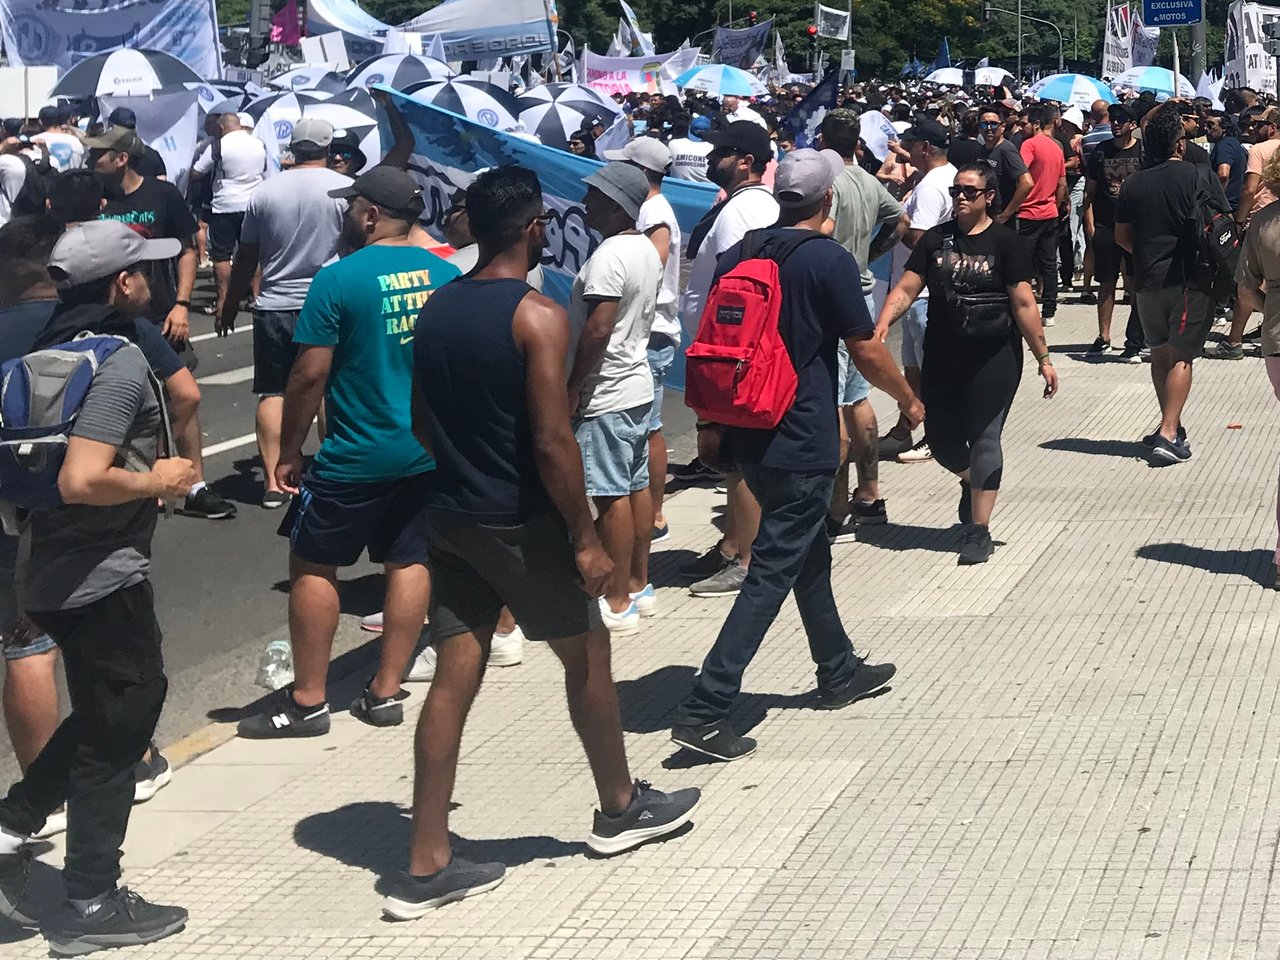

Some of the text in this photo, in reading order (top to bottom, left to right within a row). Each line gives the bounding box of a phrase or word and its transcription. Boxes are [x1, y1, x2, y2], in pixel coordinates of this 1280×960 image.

[1151, 1, 1194, 10] EXCLUSIVA
[1159, 13, 1187, 21] MOTOS
[676, 154, 706, 162] AMICONE
[376, 269, 431, 292] PARTY
[381, 289, 436, 315] AT TH
[386, 313, 418, 335] RAC
